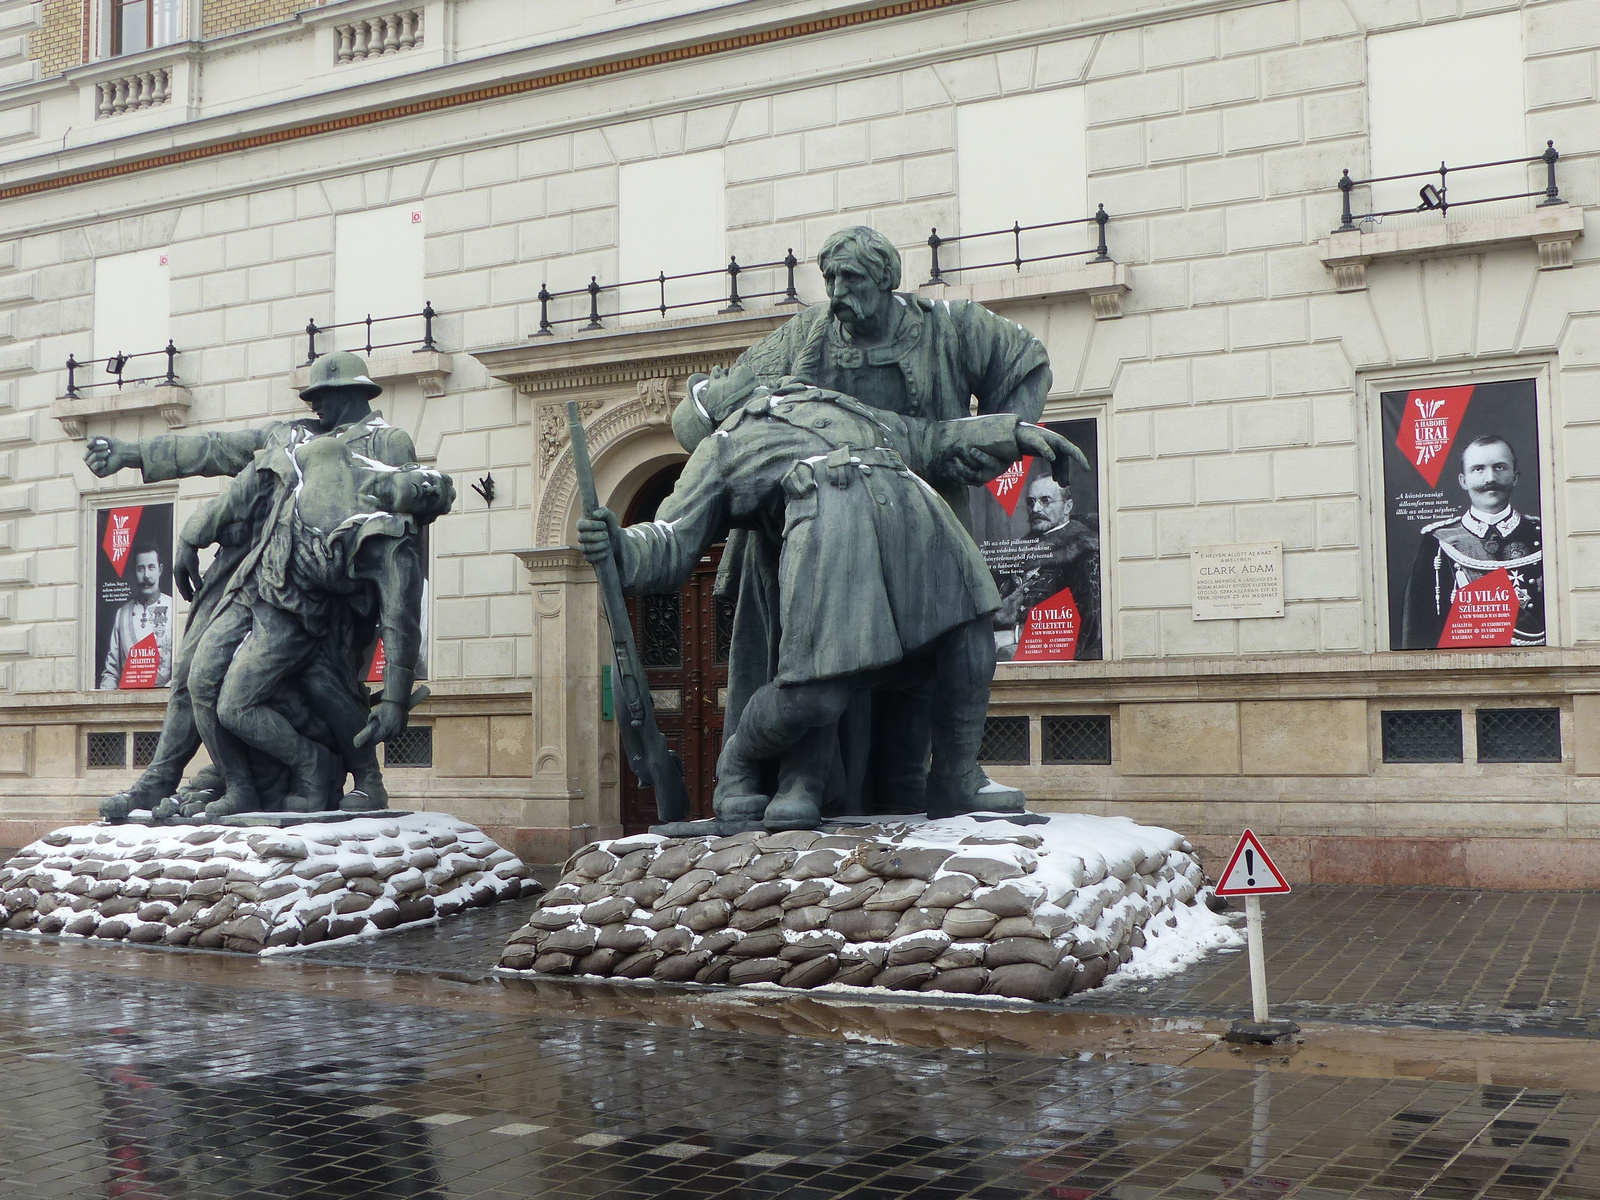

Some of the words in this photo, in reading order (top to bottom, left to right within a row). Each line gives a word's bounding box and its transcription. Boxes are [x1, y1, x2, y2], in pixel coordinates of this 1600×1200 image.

[1415, 426, 1447, 440] URAI
[1199, 566, 1236, 576] CLARK
[1241, 563, 1274, 574] ÁDÁM
[1459, 588, 1472, 603] ÚJ
[1474, 586, 1509, 602] VILÁG
[1031, 607, 1042, 621] ÚJ
[1044, 606, 1073, 620] VILÁG
[1459, 604, 1501, 613] SZÜLETETT
[1031, 621, 1065, 630] SZÜLETETT
[130, 647, 137, 658] ÚJ
[138, 646, 156, 657] VILÁG
